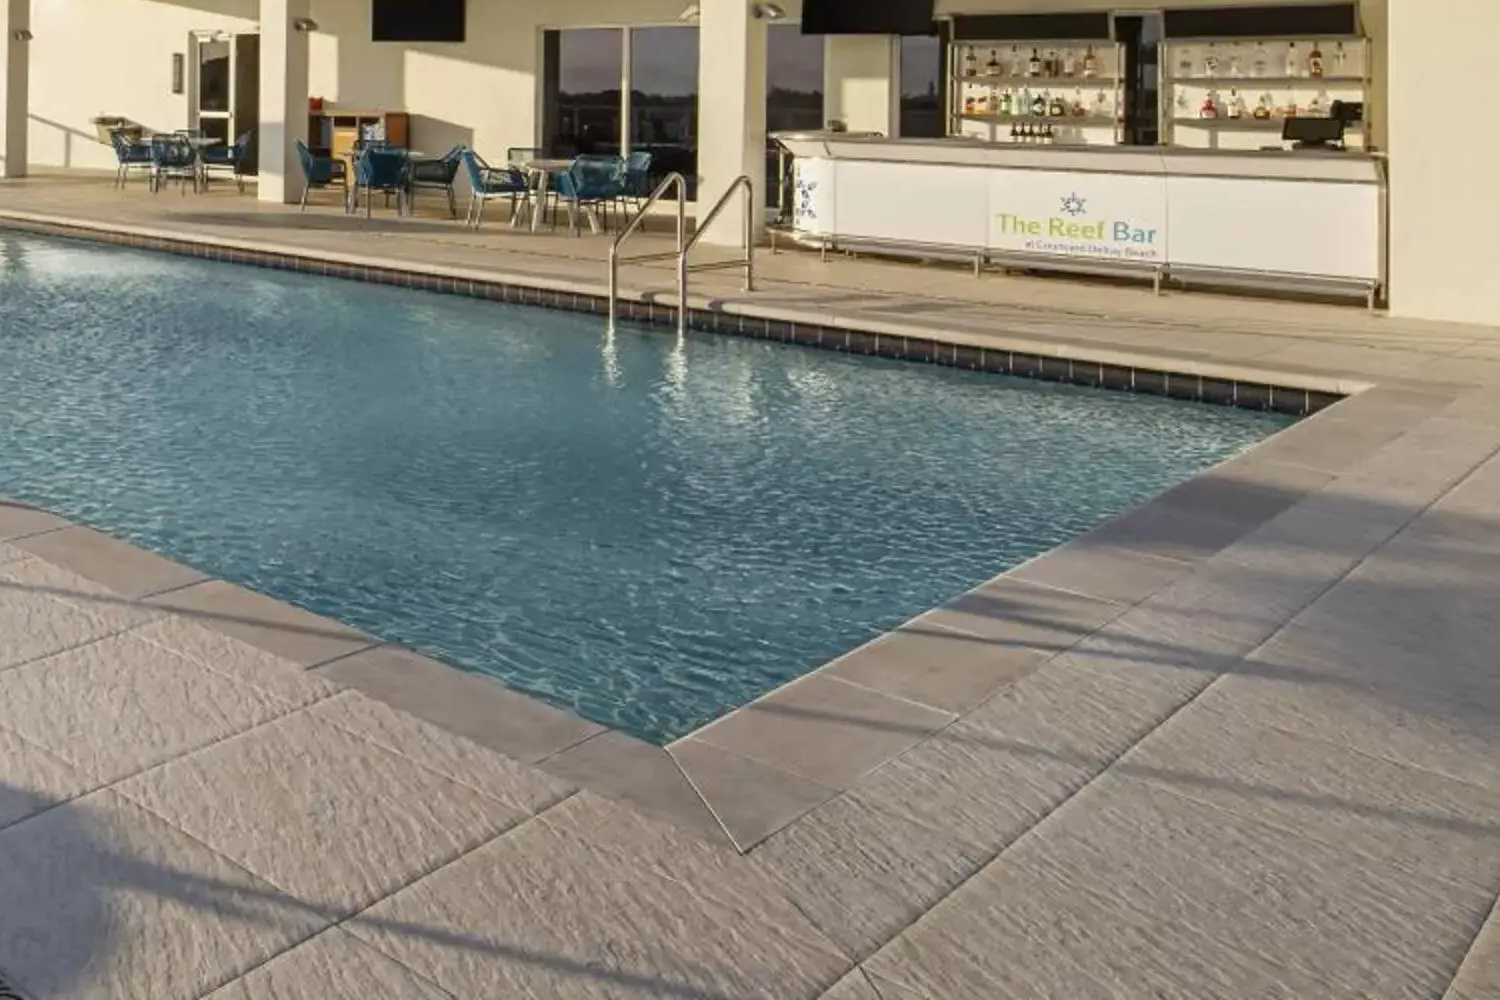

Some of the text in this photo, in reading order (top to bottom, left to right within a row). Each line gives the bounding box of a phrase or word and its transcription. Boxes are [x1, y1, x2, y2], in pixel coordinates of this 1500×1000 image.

[995, 213, 1156, 243] The Reef Bar
